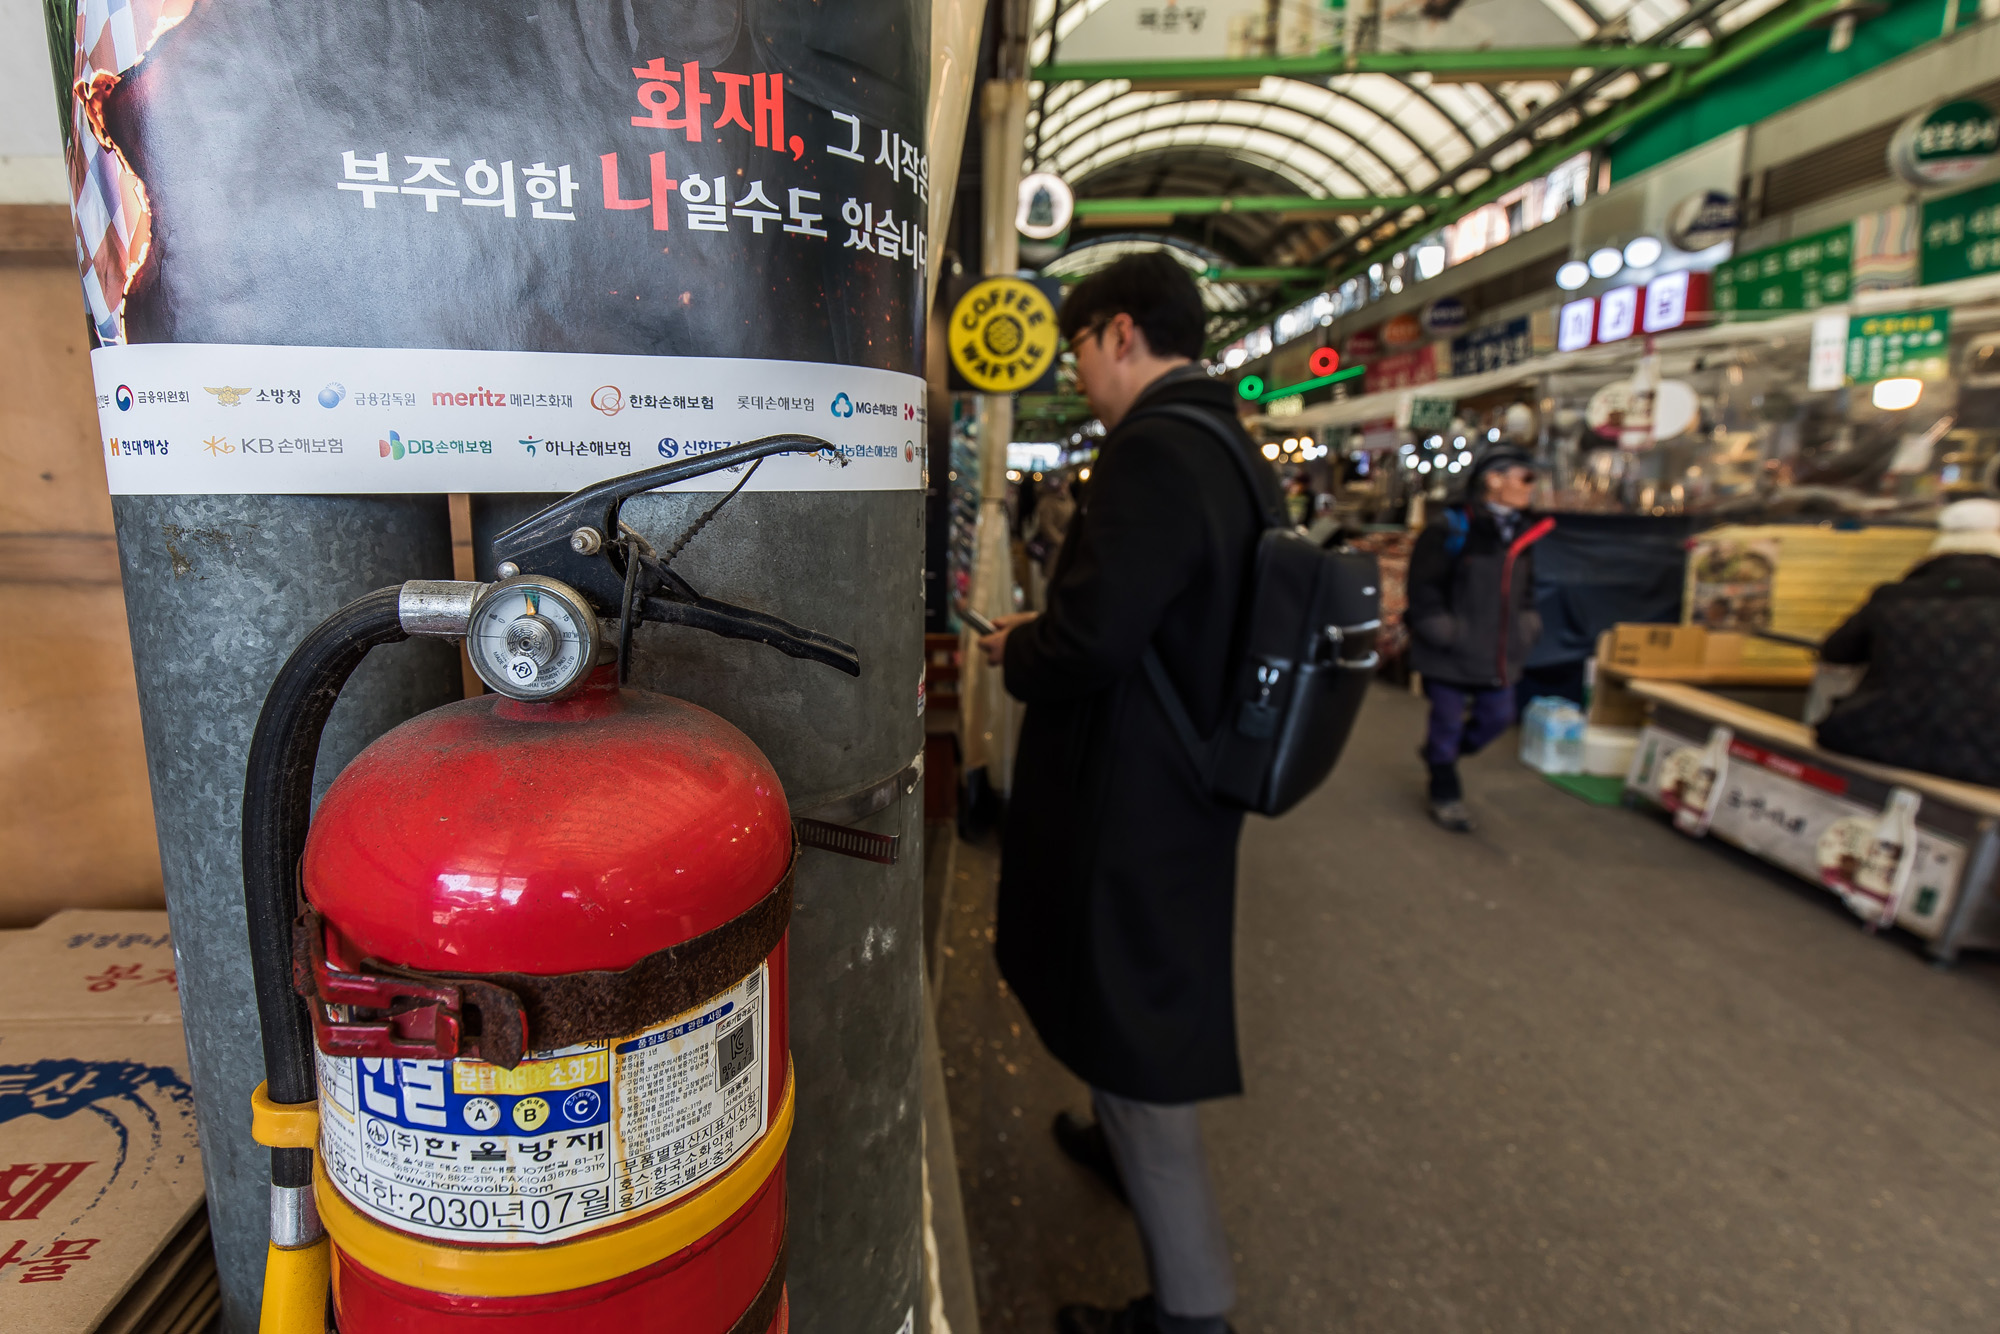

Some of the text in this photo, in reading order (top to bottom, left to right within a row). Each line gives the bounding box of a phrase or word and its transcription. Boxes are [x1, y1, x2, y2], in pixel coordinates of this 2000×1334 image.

[631, 57, 929, 205] 화재, 그 시작은
[337, 150, 580, 222] 부주의한
[961, 288, 1047, 332] COFFEE
[961, 342, 1045, 382] WAFFLE
[137, 390, 190, 404] 금융위원회
[255, 389, 301, 405] 소방청
[354, 391, 416, 407] 금융감독원
[431, 386, 573, 408] meritz 메리츠화재
[629, 394, 714, 410] 한화손해보험
[737, 395, 815, 412] 롯데손해보험
[855, 402, 898, 417] MG손해보험
[121, 438, 169, 456] 현대해상
[409, 440, 492, 455] DB손해보험
[545, 440, 631, 457] 하나손해보험
[512, 663, 529, 675] KFI
[637, 1025, 684, 1049] 품질보증에
[707, 1008, 722, 1022] 사항
[474, 1108, 487, 1122] A
[524, 1108, 537, 1122] B
[574, 1100, 588, 1115] C
[393, 1172, 554, 1195] www.hanwoolbj.com
